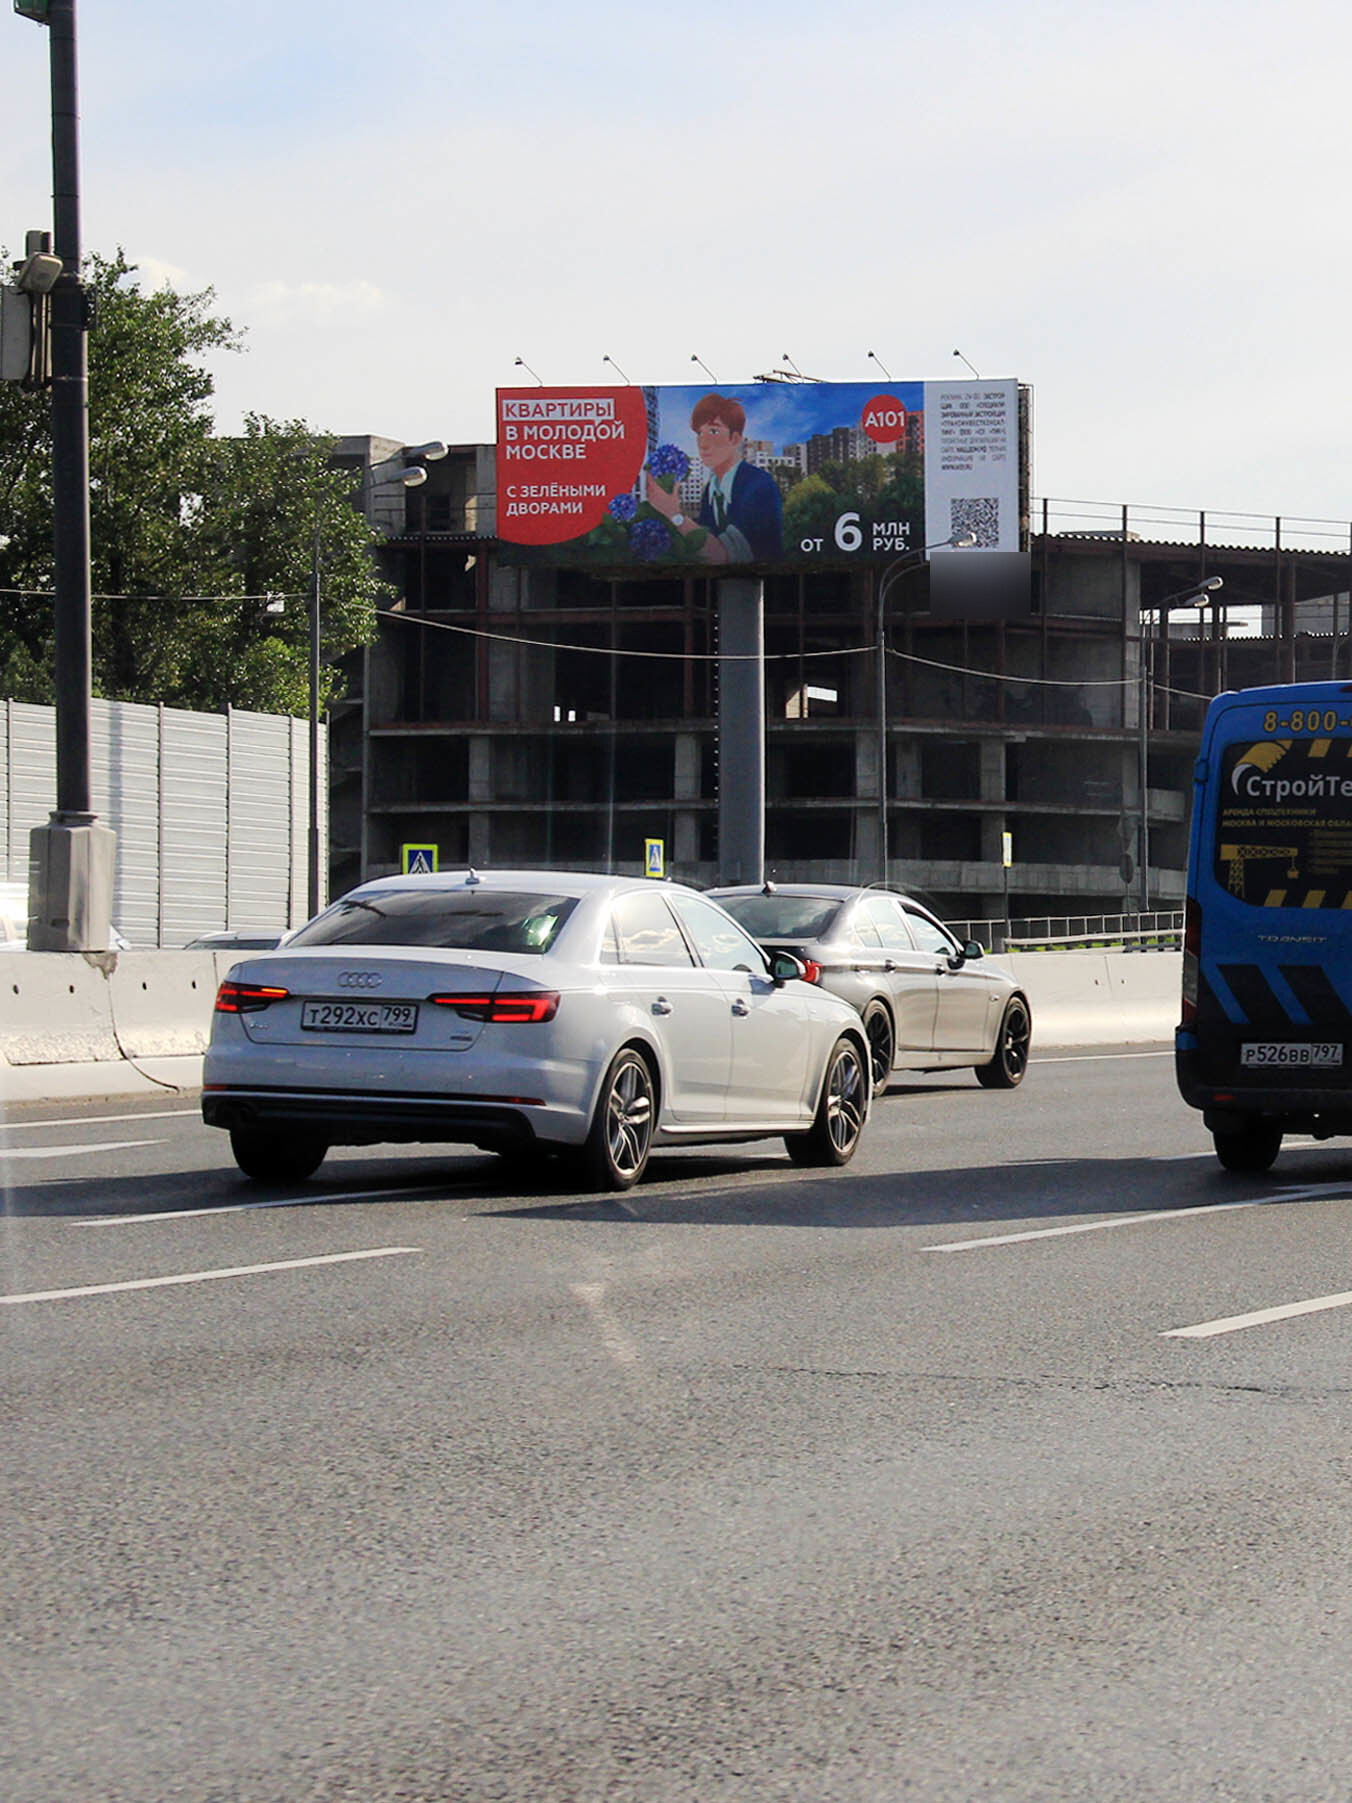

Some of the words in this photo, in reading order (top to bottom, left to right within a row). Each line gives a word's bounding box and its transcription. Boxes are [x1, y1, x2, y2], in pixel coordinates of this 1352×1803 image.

[505, 402, 612, 418] КВАРТИРЫ
[864, 410, 905, 428] А101
[505, 426, 518, 440] В
[523, 421, 625, 442] МОЛОДОЙ
[505, 444, 587, 460] МОСКВЕ
[506, 485, 517, 498] С
[519, 482, 606, 497] ЗЕЛЁНЫМИ
[506, 502, 583, 517] ДВОРАМИ
[800, 538, 824, 552] ОТ
[834, 511, 863, 552] 6
[872, 522, 910, 536] МЛН
[872, 537, 910, 551] РУБ.
[1257, 935, 1328, 943] TRANSIT
[309, 1006, 379, 1026] Т292ХС
[383, 1006, 412, 1022] 799
[1246, 1046, 1310, 1063] Р526ВВ
[1311, 1045, 1338, 1058] 797
